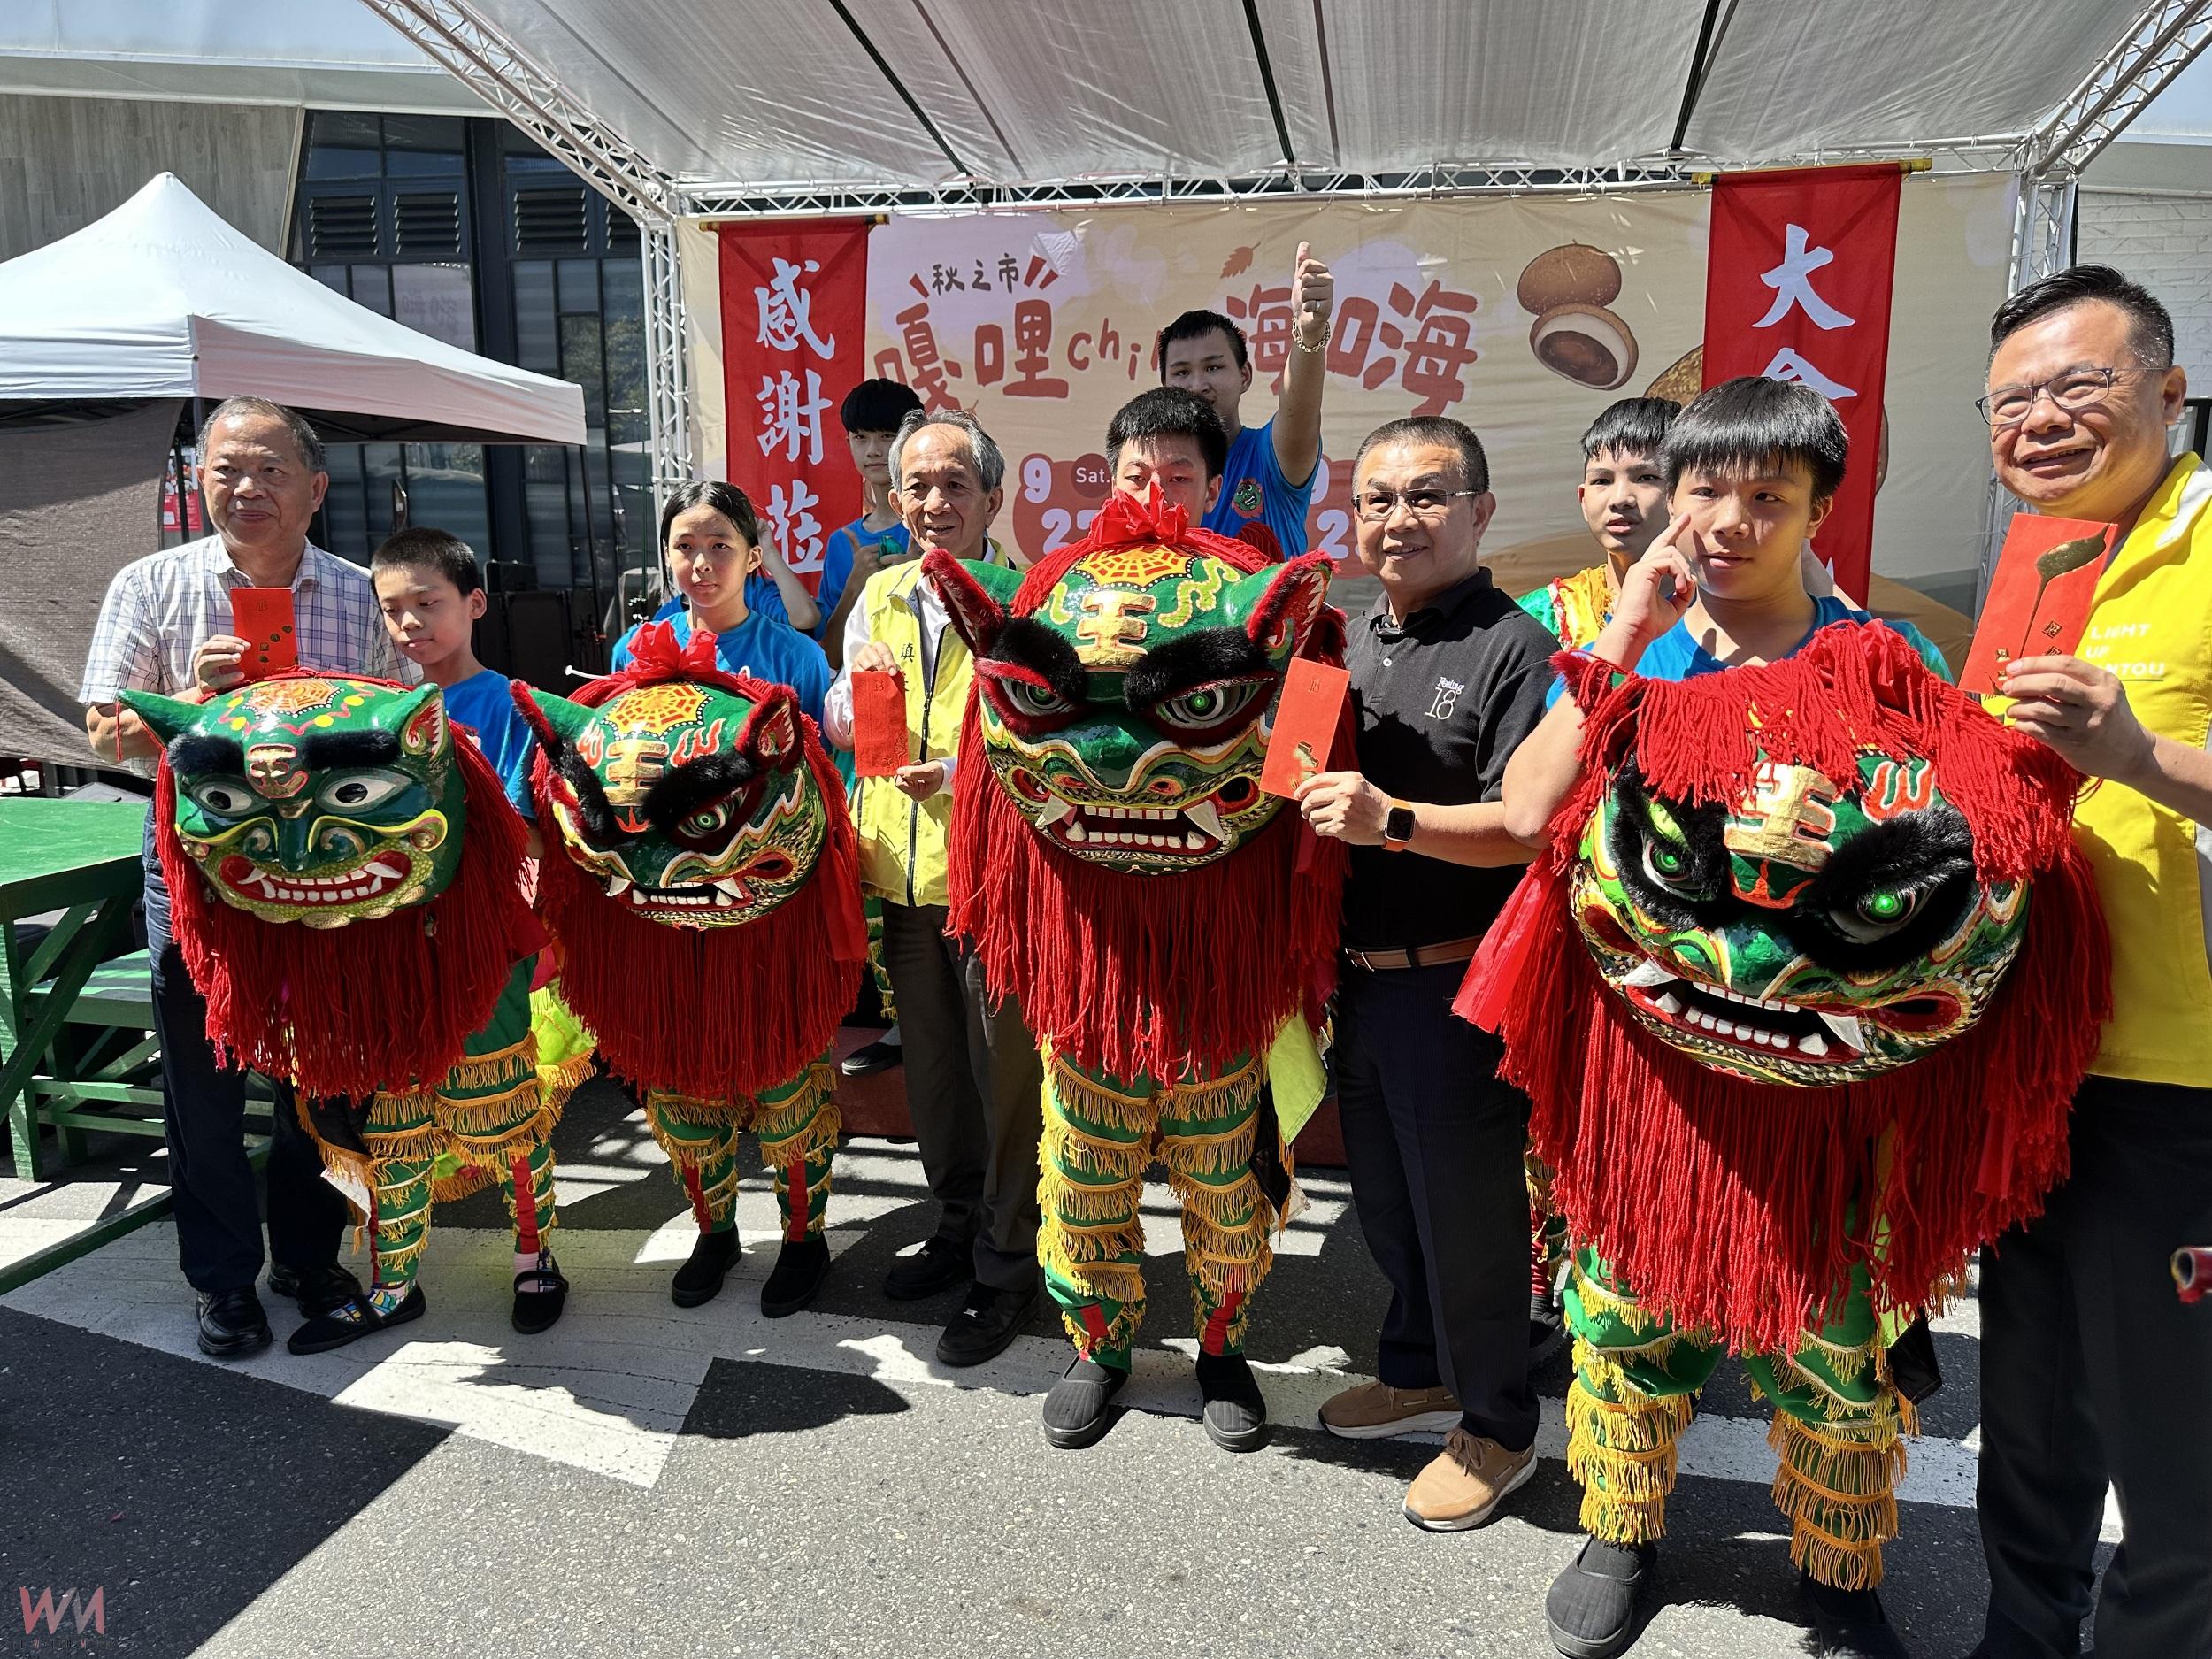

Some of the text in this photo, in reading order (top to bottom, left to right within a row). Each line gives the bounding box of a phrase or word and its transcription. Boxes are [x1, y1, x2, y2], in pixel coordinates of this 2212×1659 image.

[932, 252, 1019, 296] 秋之市
[873, 298, 1070, 413] 嘎哩
[1023, 457, 1111, 503] 9 Sat.
[1317, 509, 1360, 559] 2
[2090, 623, 2153, 641] LIGHT
[2085, 644, 2110, 659] UP
[2106, 660, 2165, 677] NTOU
[1424, 687, 1457, 720] 18
